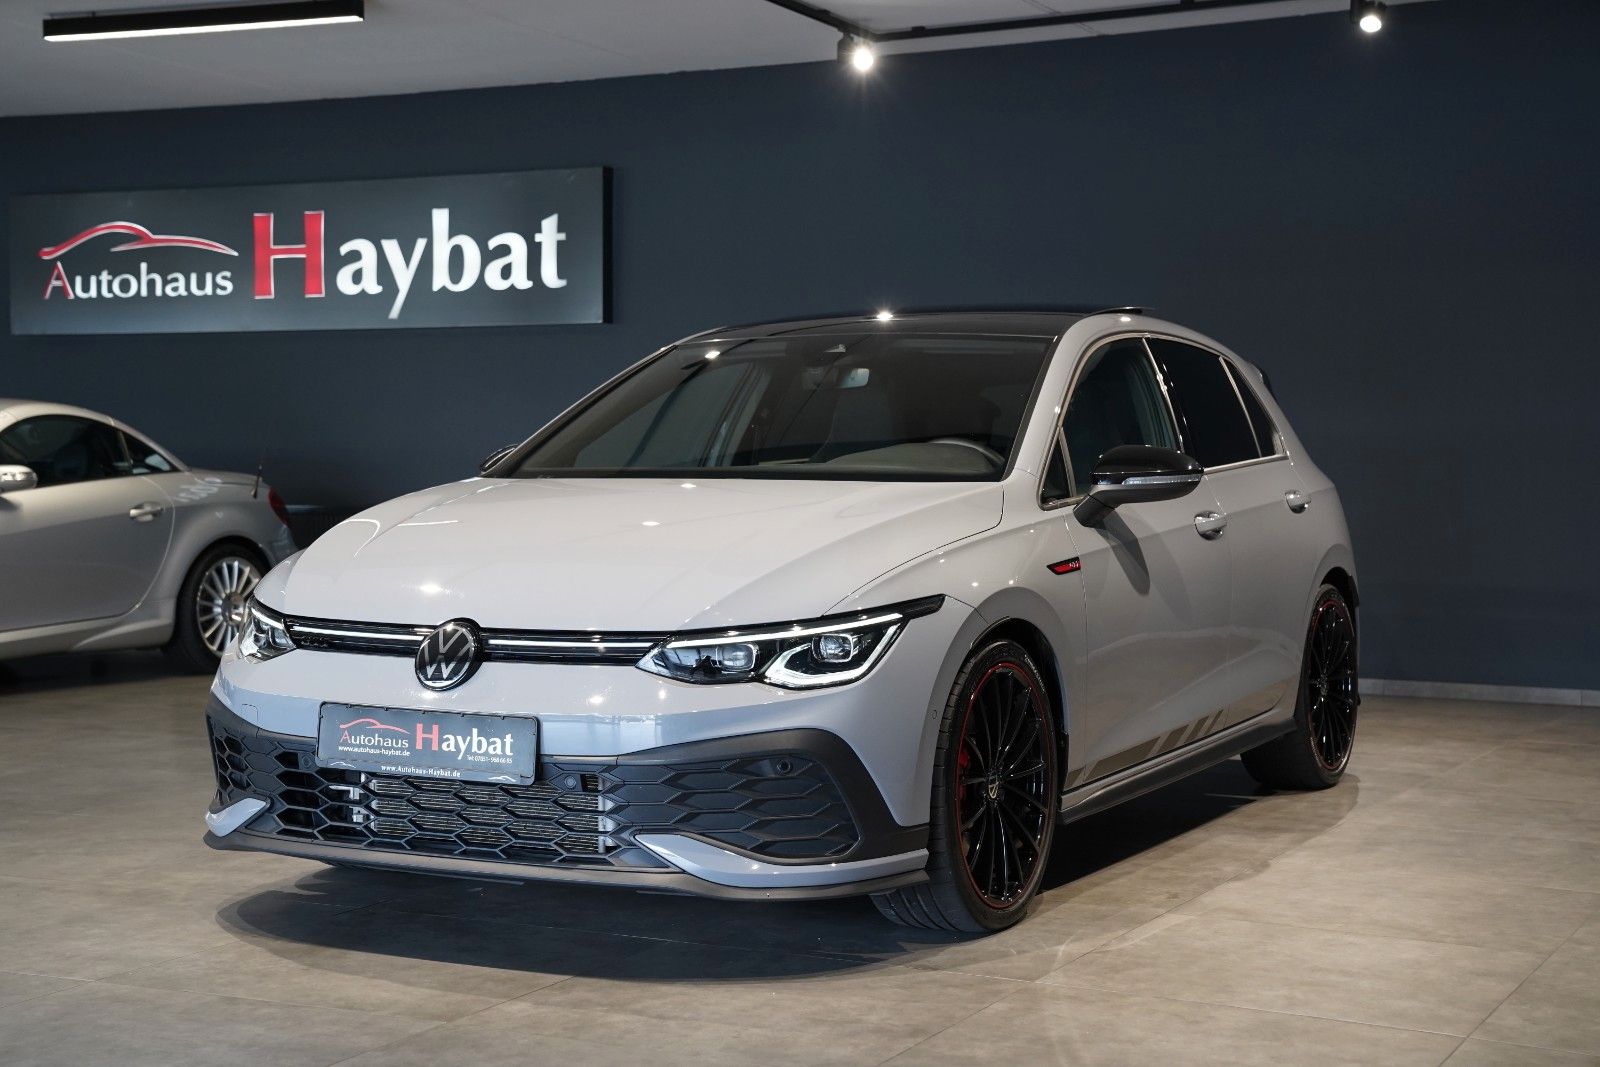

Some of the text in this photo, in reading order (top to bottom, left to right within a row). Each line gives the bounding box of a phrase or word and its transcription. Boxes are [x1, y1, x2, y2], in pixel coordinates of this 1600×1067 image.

[44, 208, 568, 320] Autohaus Haybat
[338, 745, 411, 757] www.autohaus-haybat.de
[340, 723, 514, 759] Autohaus Haybat
[380, 765, 461, 778] www.Autohaus-Haybat.de
